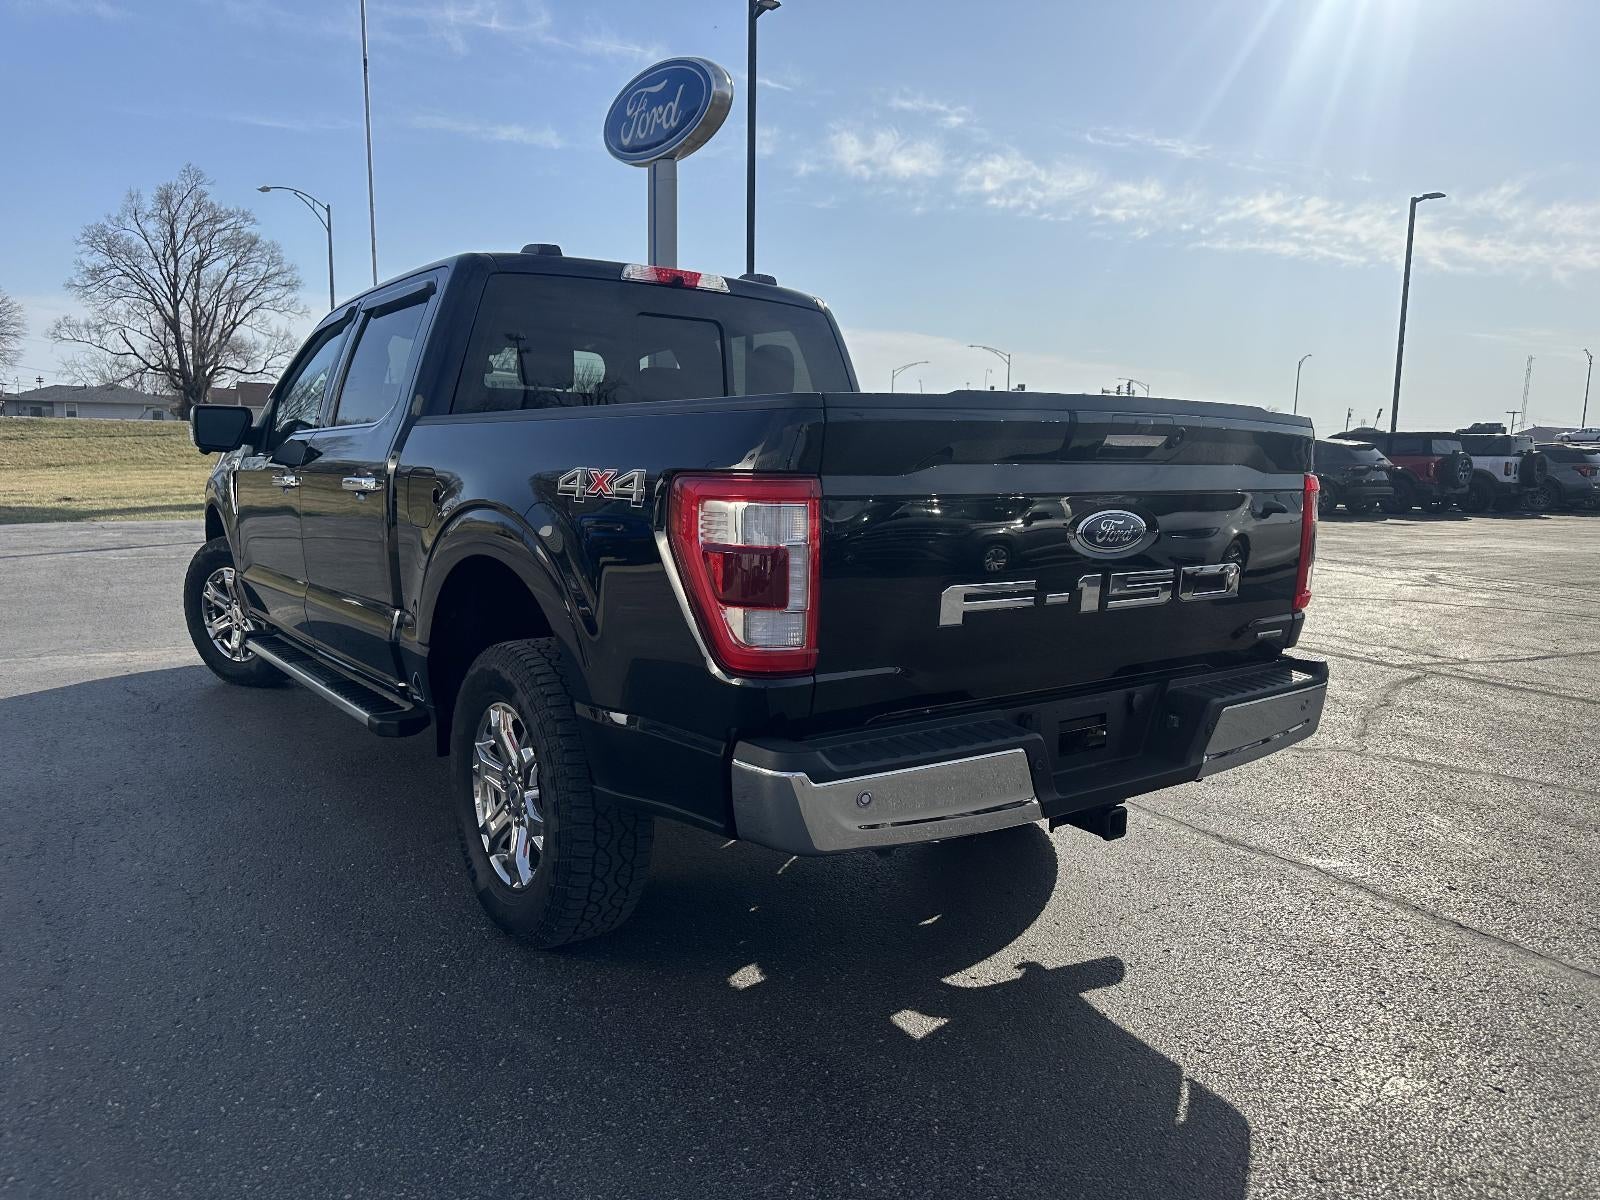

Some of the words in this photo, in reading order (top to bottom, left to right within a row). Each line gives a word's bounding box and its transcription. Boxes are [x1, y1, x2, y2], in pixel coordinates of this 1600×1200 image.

[620, 79, 685, 146] Ford
[1095, 518, 1136, 545] Ford
[937, 562, 1241, 628] F-150
